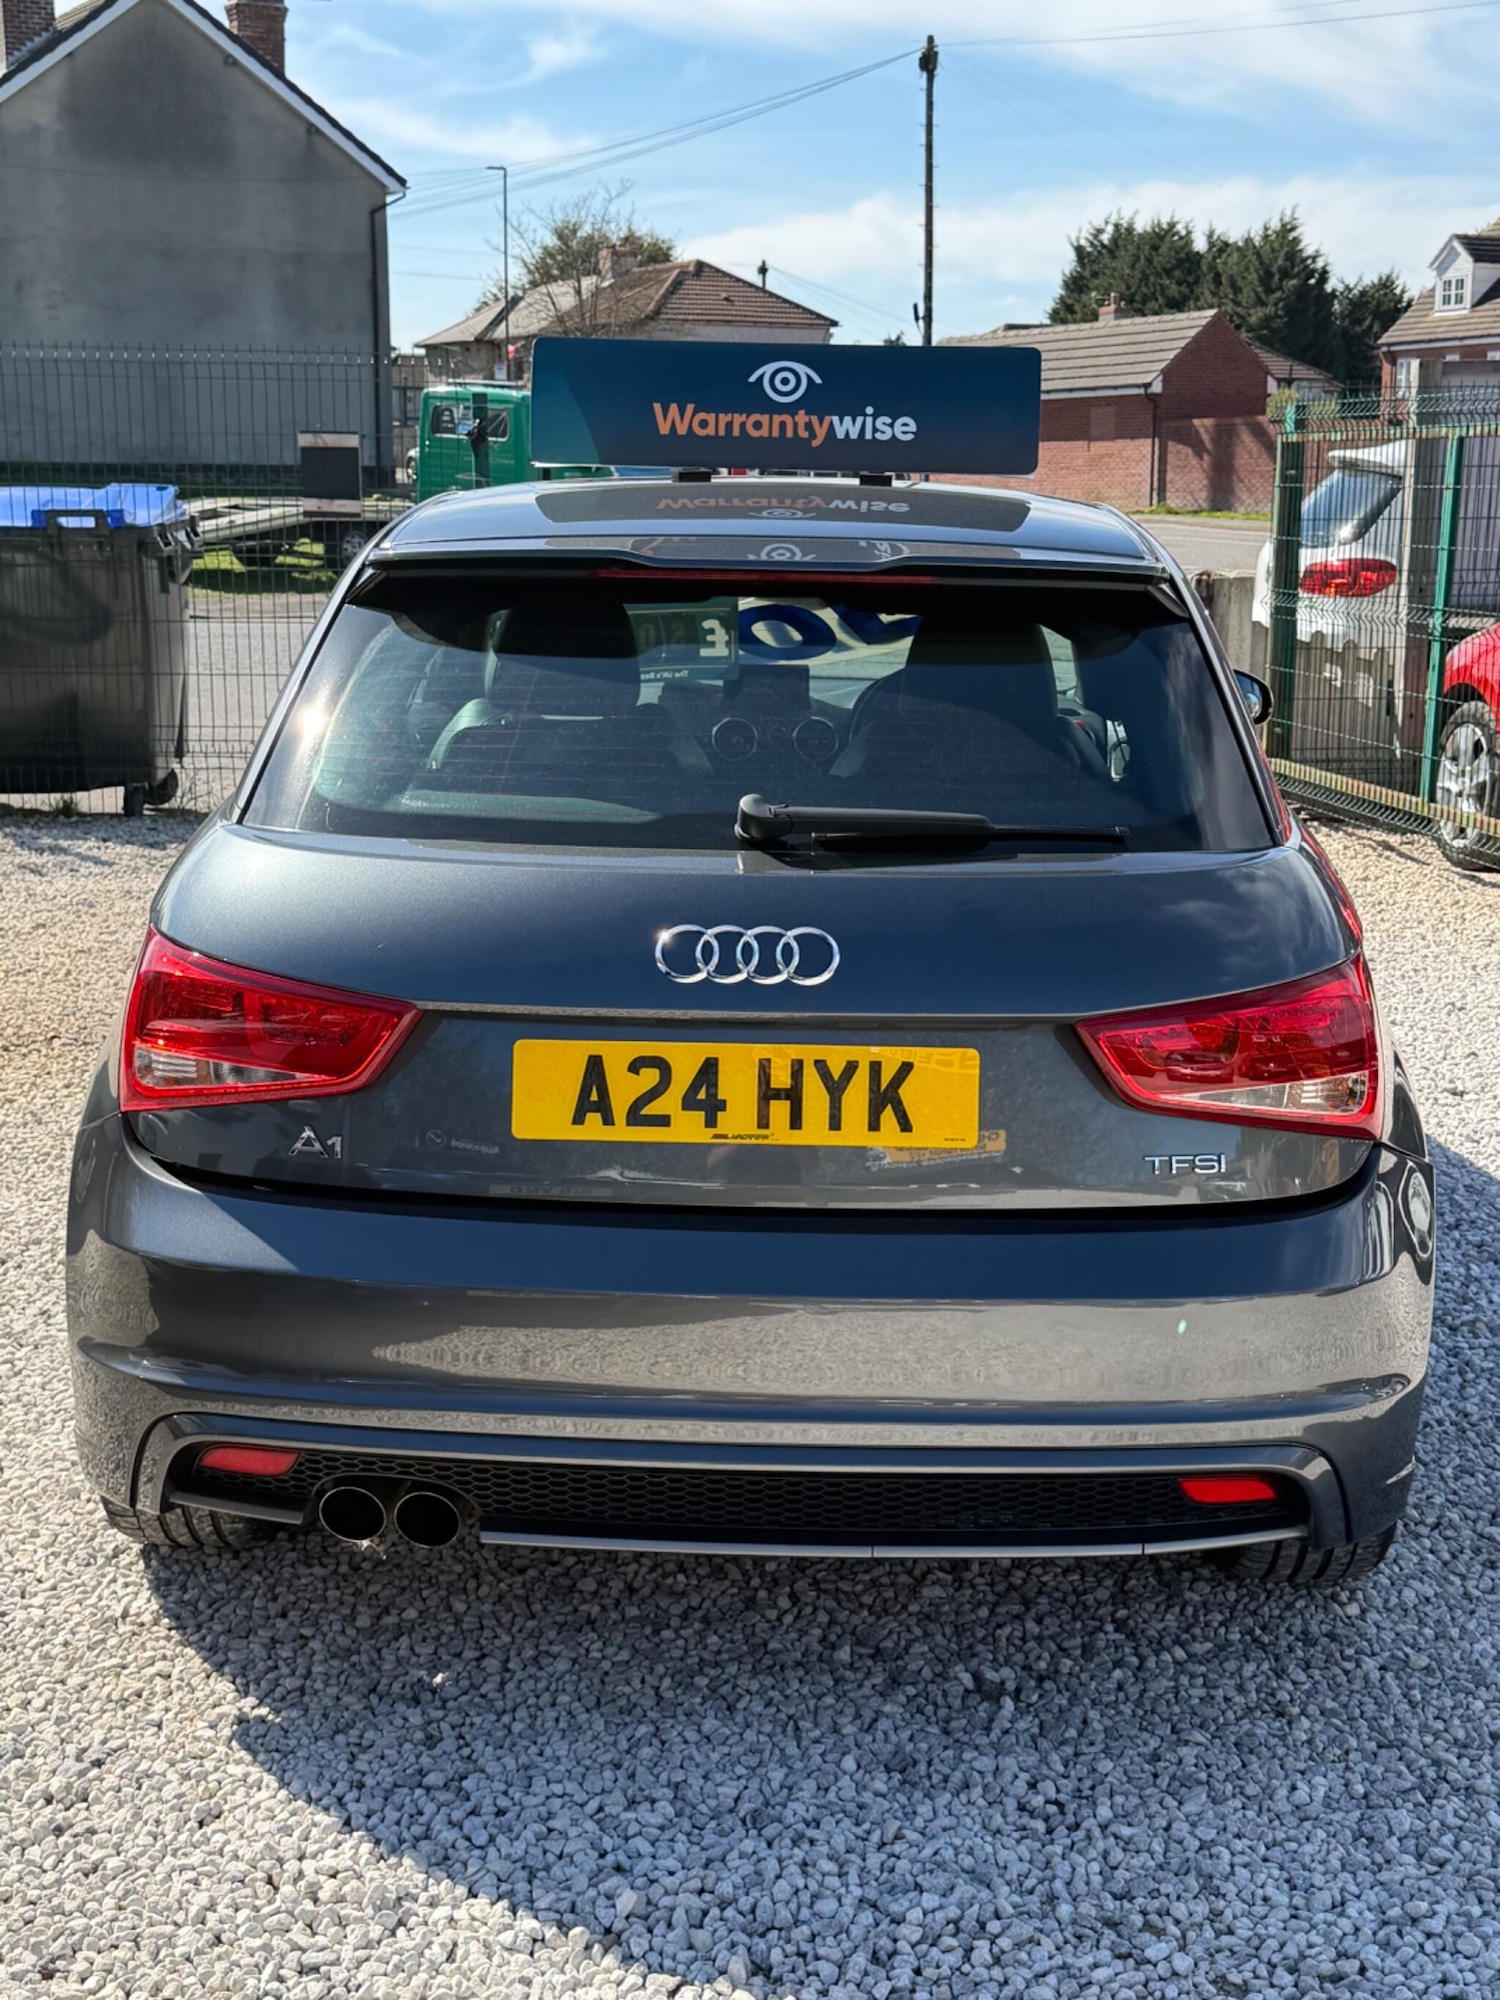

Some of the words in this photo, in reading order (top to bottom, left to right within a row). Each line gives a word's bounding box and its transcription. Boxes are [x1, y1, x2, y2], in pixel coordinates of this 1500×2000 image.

[653, 402, 917, 448] Warrantywise
[571, 1053, 727, 1129] A24
[756, 1057, 914, 1133] HYK
[288, 1125, 342, 1159] A1
[1144, 1154, 1226, 1175] TFSI
